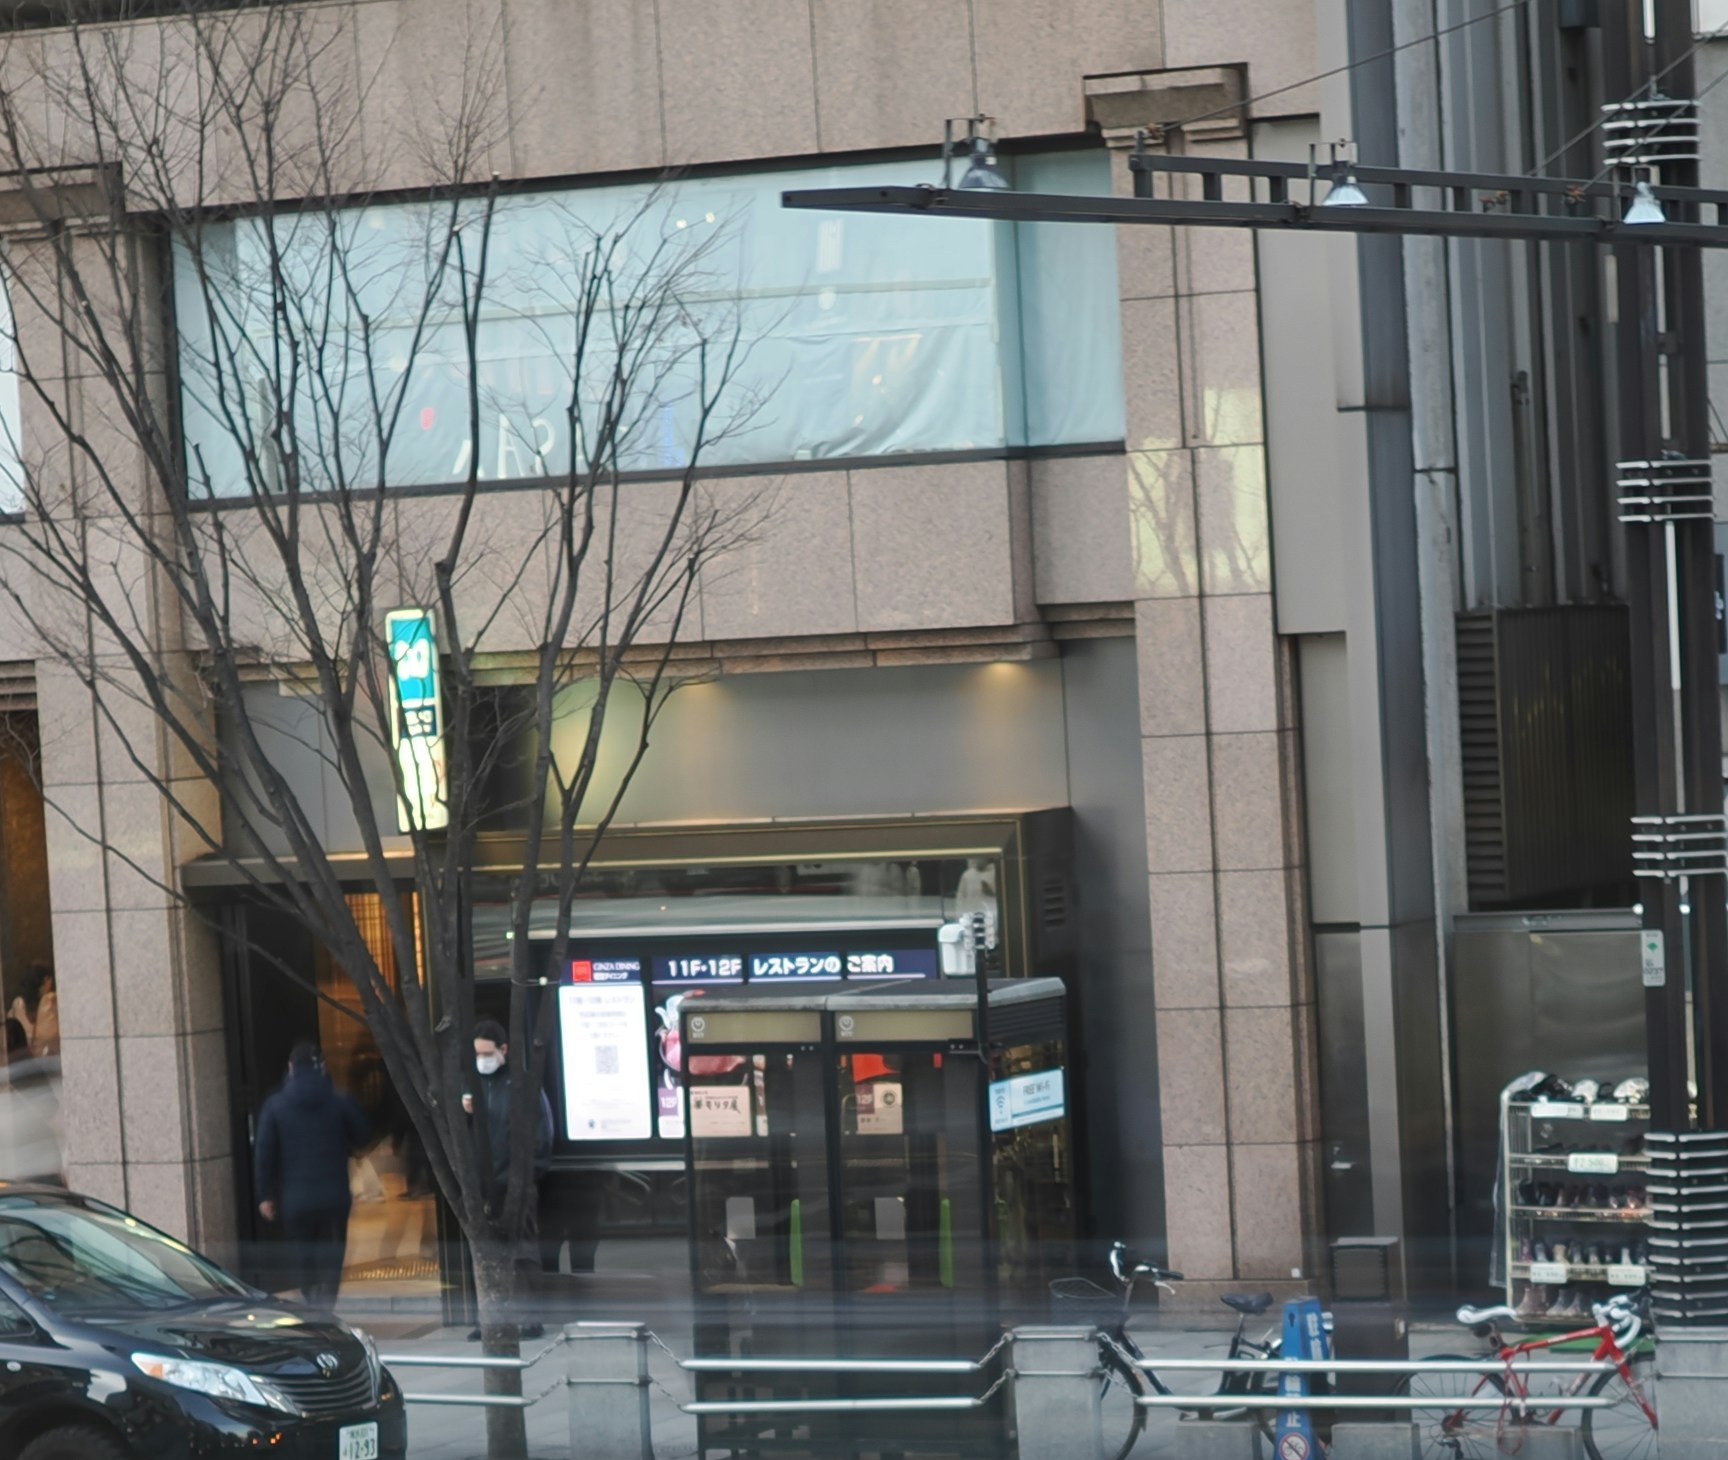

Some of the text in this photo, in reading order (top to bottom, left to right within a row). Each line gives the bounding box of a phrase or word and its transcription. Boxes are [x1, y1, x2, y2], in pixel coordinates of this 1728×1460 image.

[592, 962, 614, 972] GINZA
[753, 955, 841, 976] レストランの
[847, 955, 894, 973] ご案内
